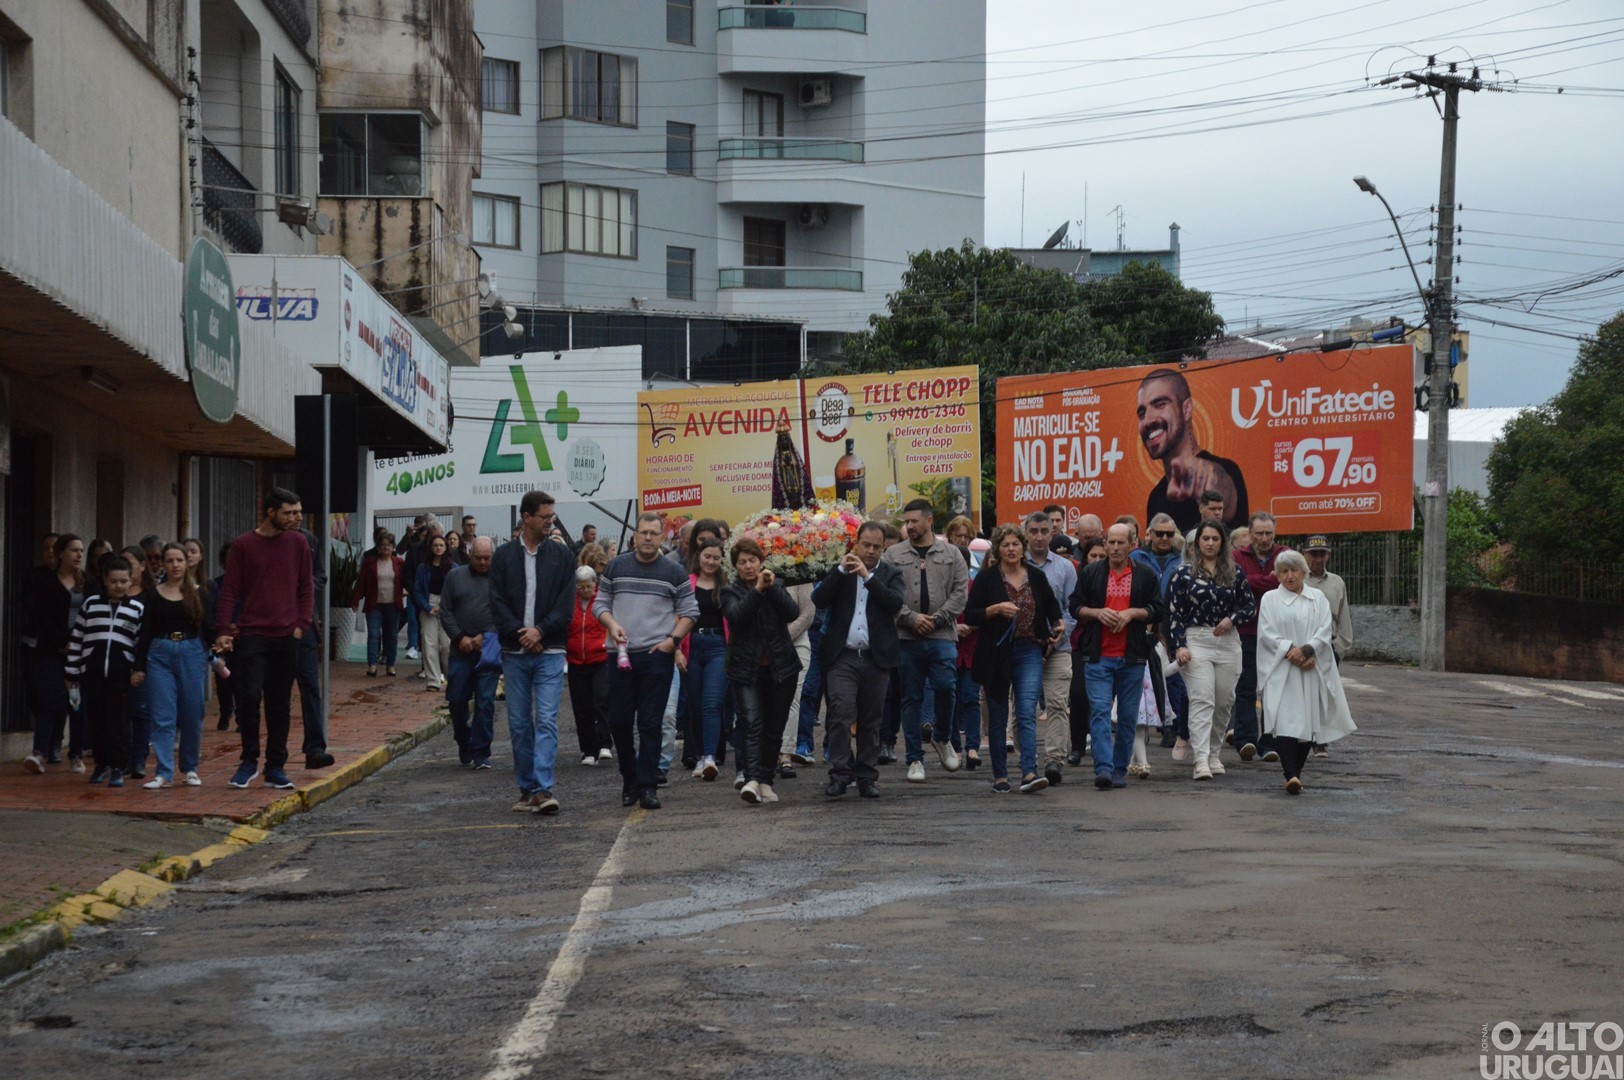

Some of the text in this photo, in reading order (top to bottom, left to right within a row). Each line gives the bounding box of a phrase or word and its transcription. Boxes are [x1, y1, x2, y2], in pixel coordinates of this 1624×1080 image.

[236, 299, 313, 319] ILVA
[687, 396, 732, 406] MERCADO
[745, 391, 791, 402] AÇOUGUE
[863, 377, 971, 405] TELE CHOPP
[1267, 382, 1395, 418] UniFatecie
[821, 412, 842, 427] Beer
[878, 403, 966, 422] 55 99926-2346
[1267, 411, 1396, 427] CENTRO UNIVERSITÁRIO
[683, 406, 792, 438] AVENIDA
[895, 421, 972, 437] Delivery de barris
[1013, 411, 1100, 438] MATRICULE-SE
[911, 436, 953, 448] de chopp
[684, 454, 694, 462] DE
[906, 454, 932, 463] Entrega
[937, 450, 973, 461] instalação
[1279, 447, 1294, 455] partir
[574, 457, 595, 468] DIÁRIO
[709, 464, 724, 472] SEM
[725, 462, 752, 471] FECHAR
[753, 461, 763, 469] AO
[923, 461, 954, 474] GRÁTIS
[1013, 438, 1046, 483] NO
[1274, 436, 1377, 488] R$ 67,90
[413, 461, 455, 488] ANOS
[715, 474, 751, 482] INCLUSIVE
[667, 487, 701, 503] MEIA-NOITE
[738, 484, 772, 492] FERIADOS
[1014, 480, 1104, 502] BARATO DO BRASIL
[1298, 501, 1318, 511] com
[1318, 498, 1333, 509] até
[1334, 498, 1355, 509] 70%
